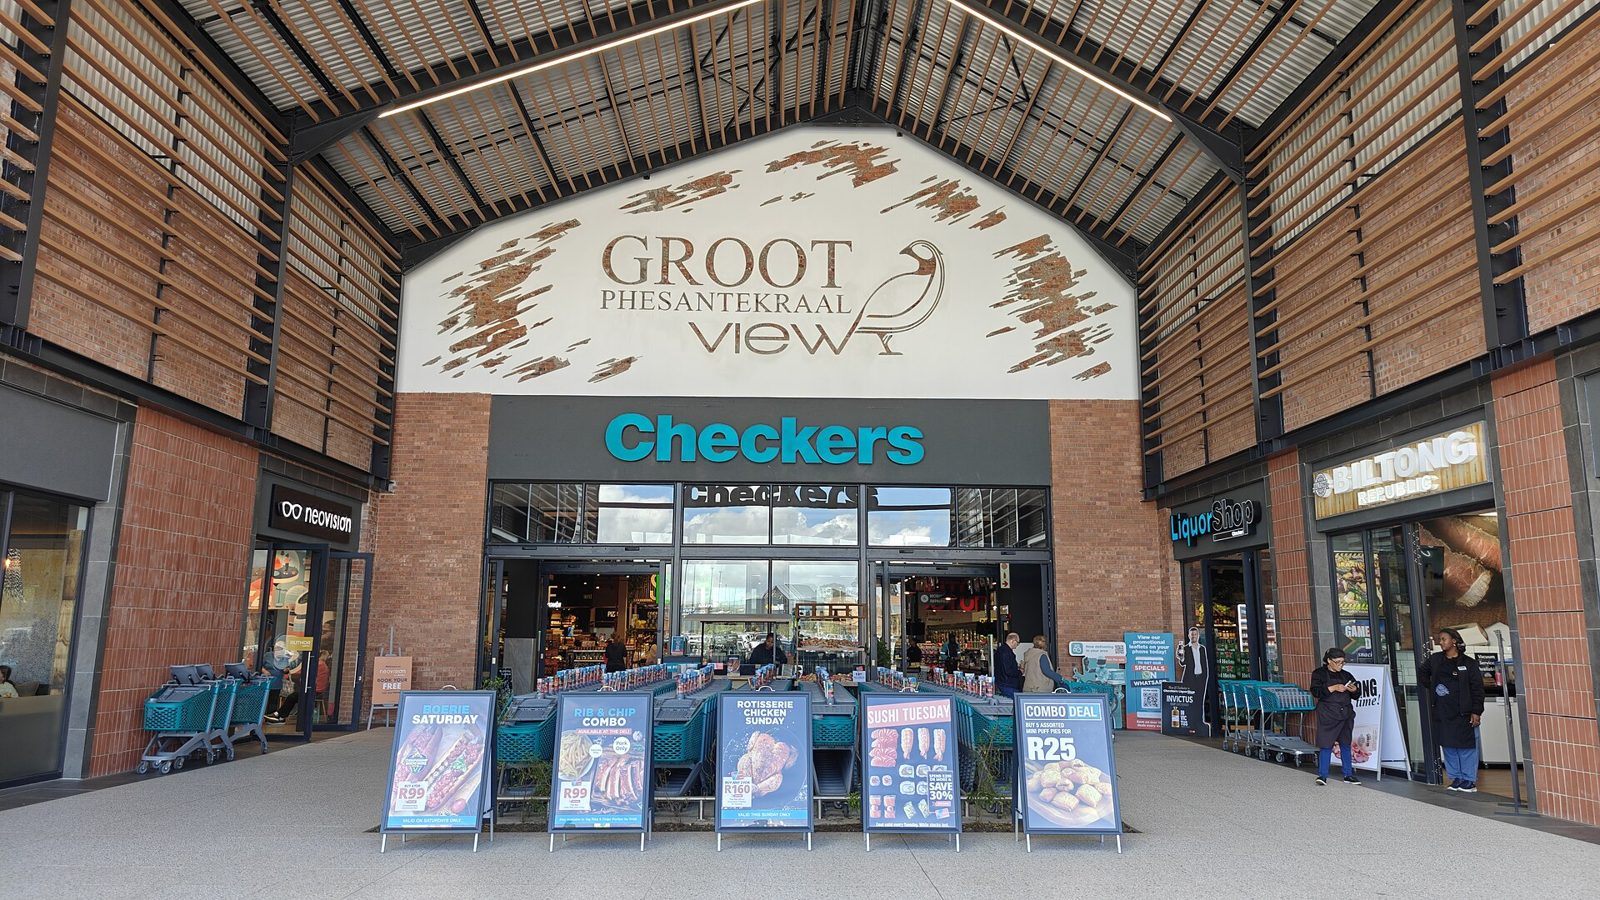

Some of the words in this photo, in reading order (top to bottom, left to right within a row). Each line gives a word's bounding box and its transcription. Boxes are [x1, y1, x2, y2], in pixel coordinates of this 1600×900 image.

[602, 235, 853, 288] GROOT
[600, 290, 852, 314] PHESANTEKRAAL
[605, 413, 925, 465] Checkers
[1333, 431, 1477, 495] BILTONG
[1357, 475, 1440, 506] REPUBLIC
[305, 506, 352, 533] neovision
[1345, 626, 1370, 638] GAME
[423, 704, 470, 714] BOERIE
[574, 708, 594, 717] RIB
[596, 708, 605, 717] &
[608, 708, 636, 717] CHIP
[868, 708, 899, 724] SUSHI
[902, 704, 950, 720] TUESDAY
[1026, 706, 1066, 717] COMBO
[1069, 706, 1098, 717] DEAL
[412, 714, 478, 724] SATURDAY
[582, 718, 626, 726] COMBO
[1027, 736, 1076, 760] R25
[563, 787, 587, 798] R99
[724, 784, 750, 794] R160
[929, 782, 952, 791] SAVE
[399, 788, 426, 800] R99
[930, 791, 953, 800] 30%
